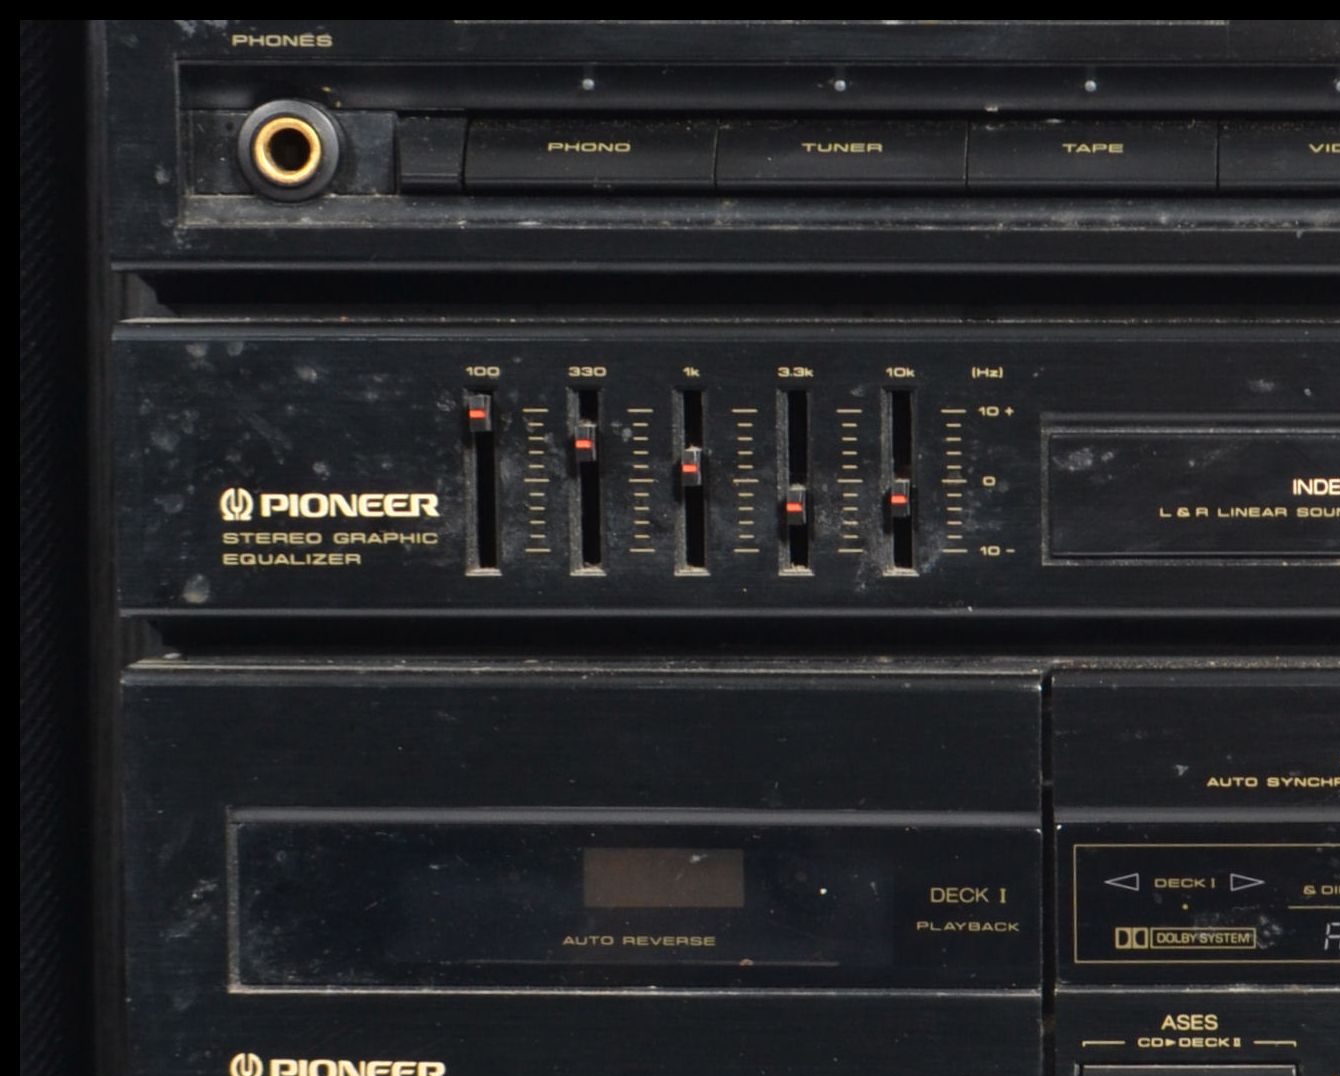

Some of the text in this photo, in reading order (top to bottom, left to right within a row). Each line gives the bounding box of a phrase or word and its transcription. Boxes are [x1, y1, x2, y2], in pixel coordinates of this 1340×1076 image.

[232, 34, 332, 47] PHONES
[548, 143, 630, 152] PHONO
[802, 143, 882, 152] TUNER
[1063, 144, 1123, 153] TAPE
[466, 367, 500, 377] 100
[569, 367, 606, 377] 330
[683, 367, 699, 376] 1k
[778, 367, 813, 377] 3.3k
[886, 367, 914, 377] 10k
[972, 367, 1003, 378] (Hz)
[261, 493, 439, 517] PIONEER
[1160, 508, 1171, 517] L
[1177, 507, 1190, 517] &
[1196, 507, 1208, 516] R
[1218, 507, 1287, 517] LINEAR
[223, 532, 438, 544] STEREO GRAPHIC
[223, 553, 361, 565] EQUALIZER
[1207, 777, 1258, 787] AUTO
[1155, 878, 1205, 888] DECK
[1303, 885, 1316, 895] &
[931, 888, 988, 903] DECK
[917, 921, 1019, 931] PLAYBACK
[563, 936, 715, 946] AUTO REVERSE
[1157, 933, 1252, 943] DOLBY SYSTEM
[1161, 1014, 1218, 1030] ASES
